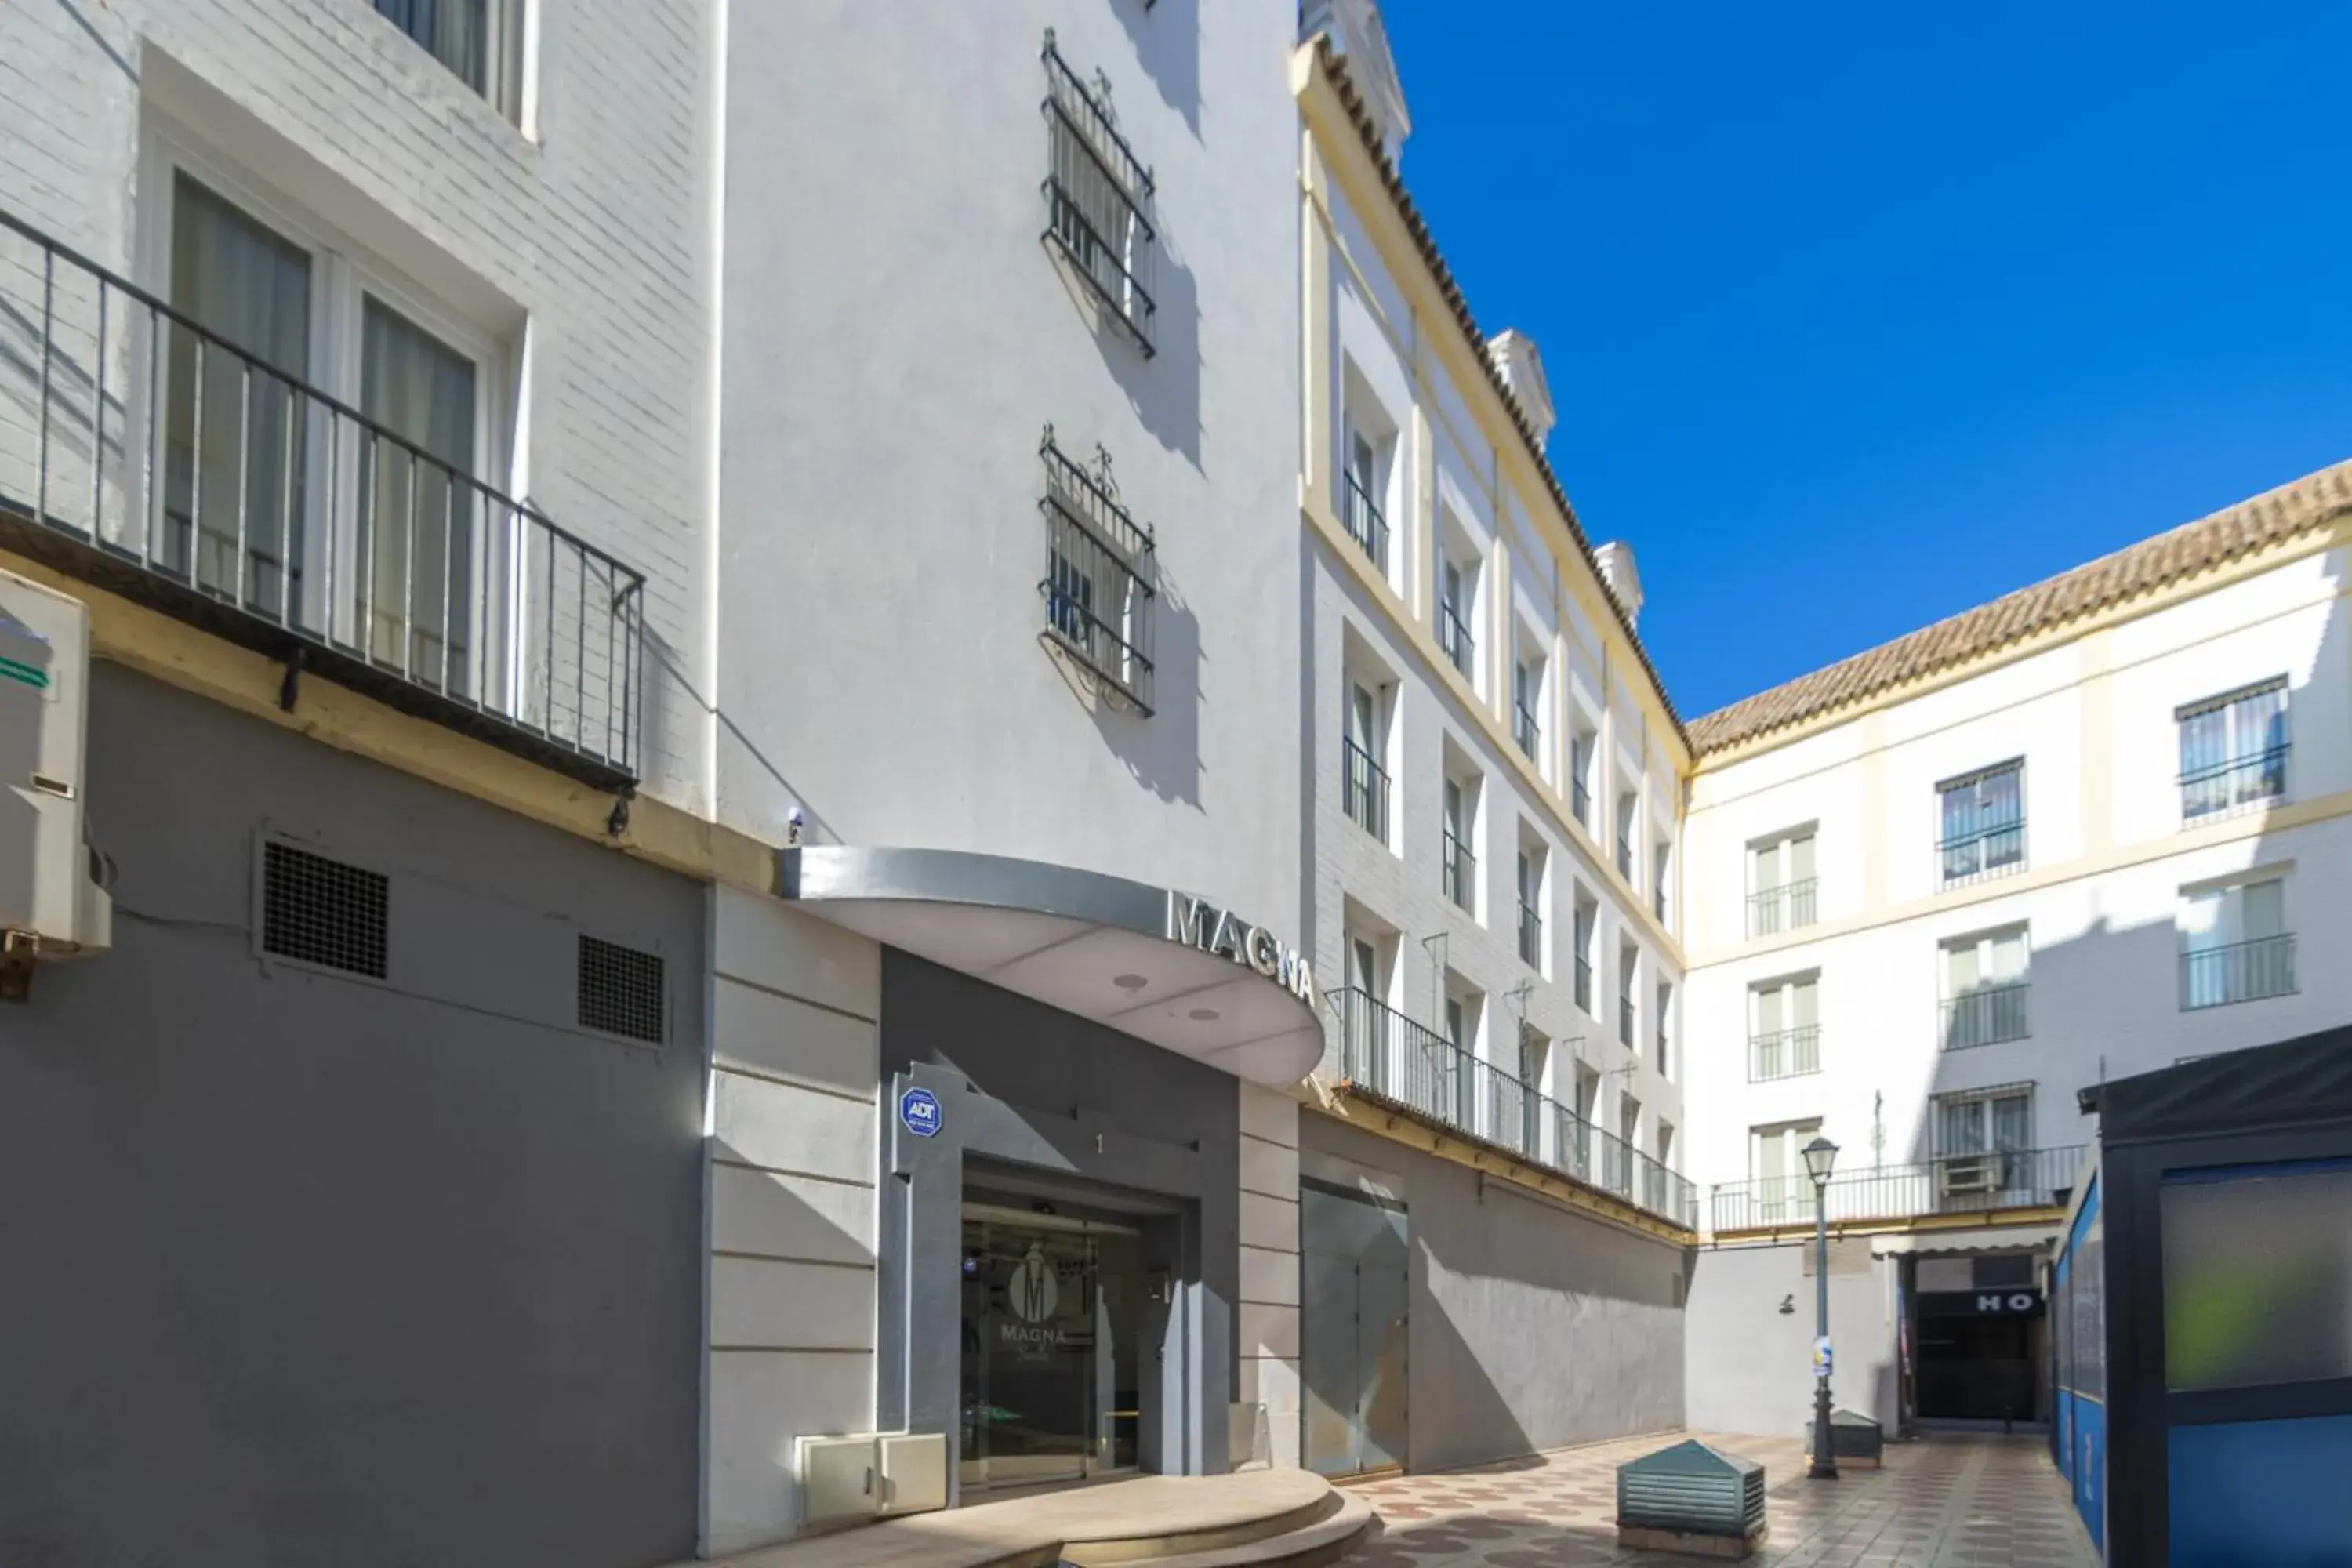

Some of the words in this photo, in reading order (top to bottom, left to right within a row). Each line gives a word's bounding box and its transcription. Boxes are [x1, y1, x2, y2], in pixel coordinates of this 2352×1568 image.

[1166, 889, 1316, 1008] MAGNA
[909, 1102, 935, 1119] ADT
[1001, 1324, 1067, 1344] MAGNA
